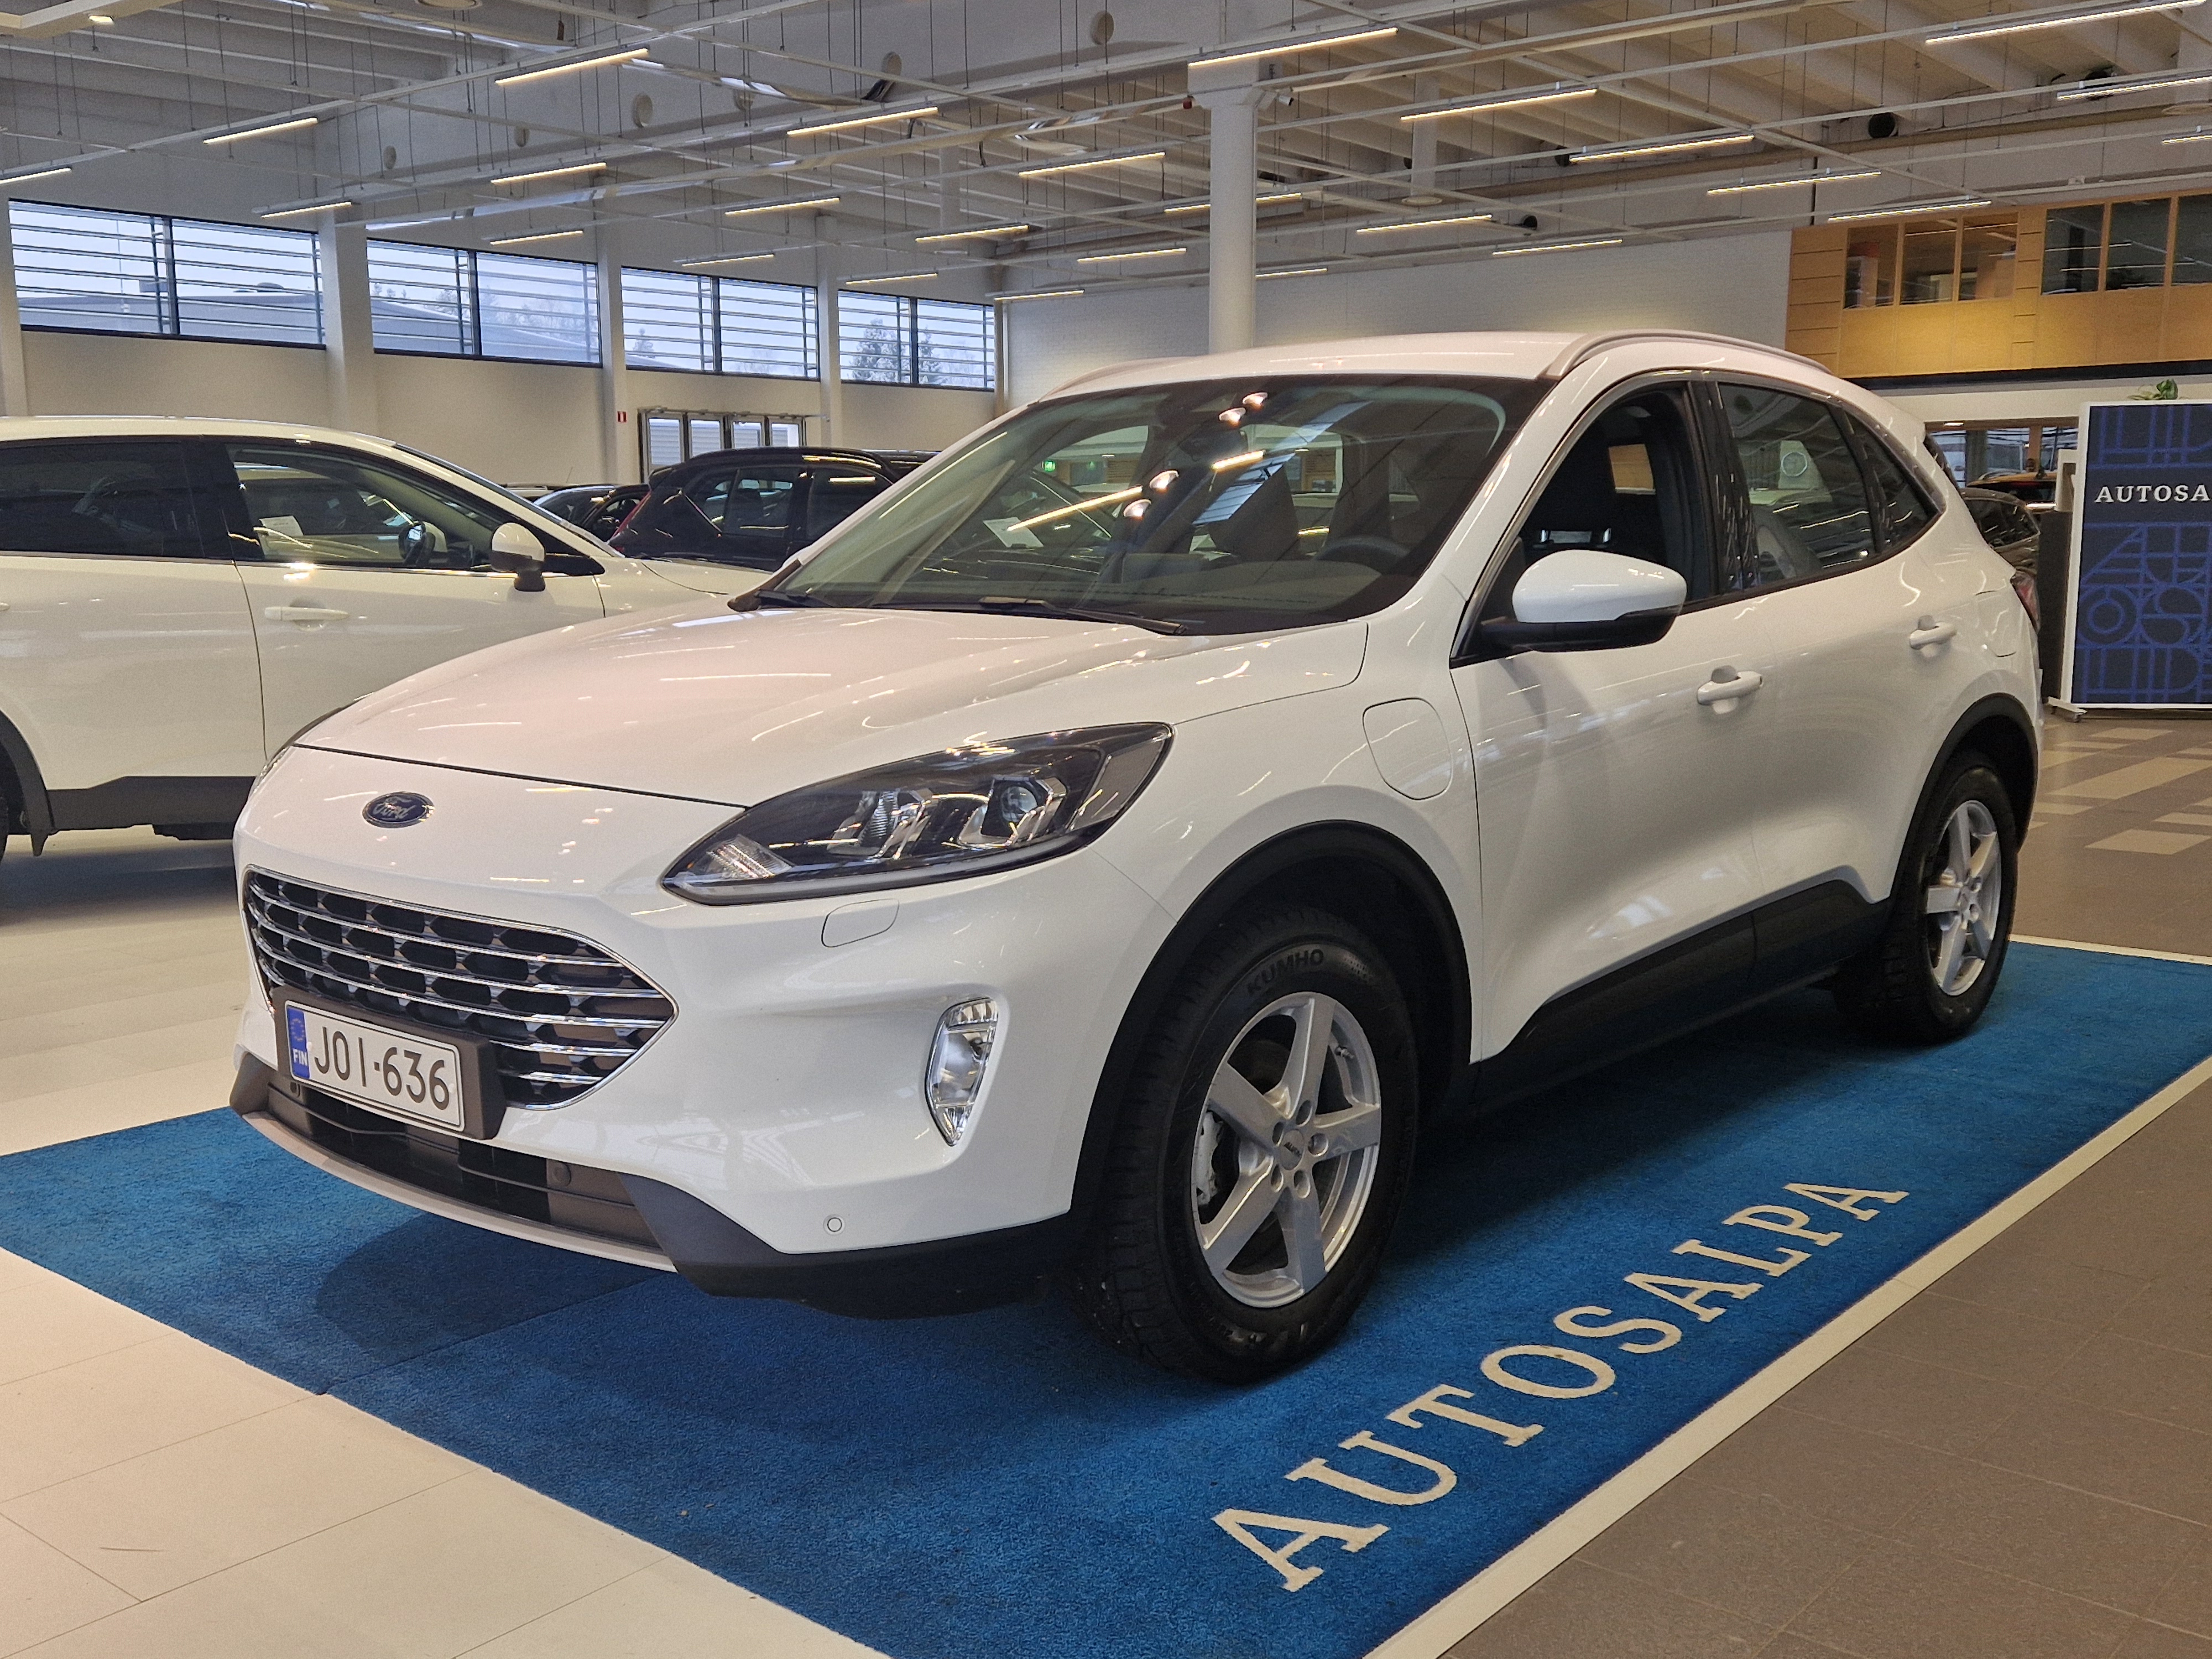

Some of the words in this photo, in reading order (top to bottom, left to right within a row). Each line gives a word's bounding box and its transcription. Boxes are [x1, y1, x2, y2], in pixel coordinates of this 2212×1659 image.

[2094, 484, 2211, 503] AUTOSA
[373, 796, 416, 820] Ford
[1247, 948, 1324, 994] KUMHO
[293, 1048, 307, 1066] FIN
[314, 1026, 449, 1110] JOI-636
[1212, 1182, 1910, 1593] AUTOSALPA
